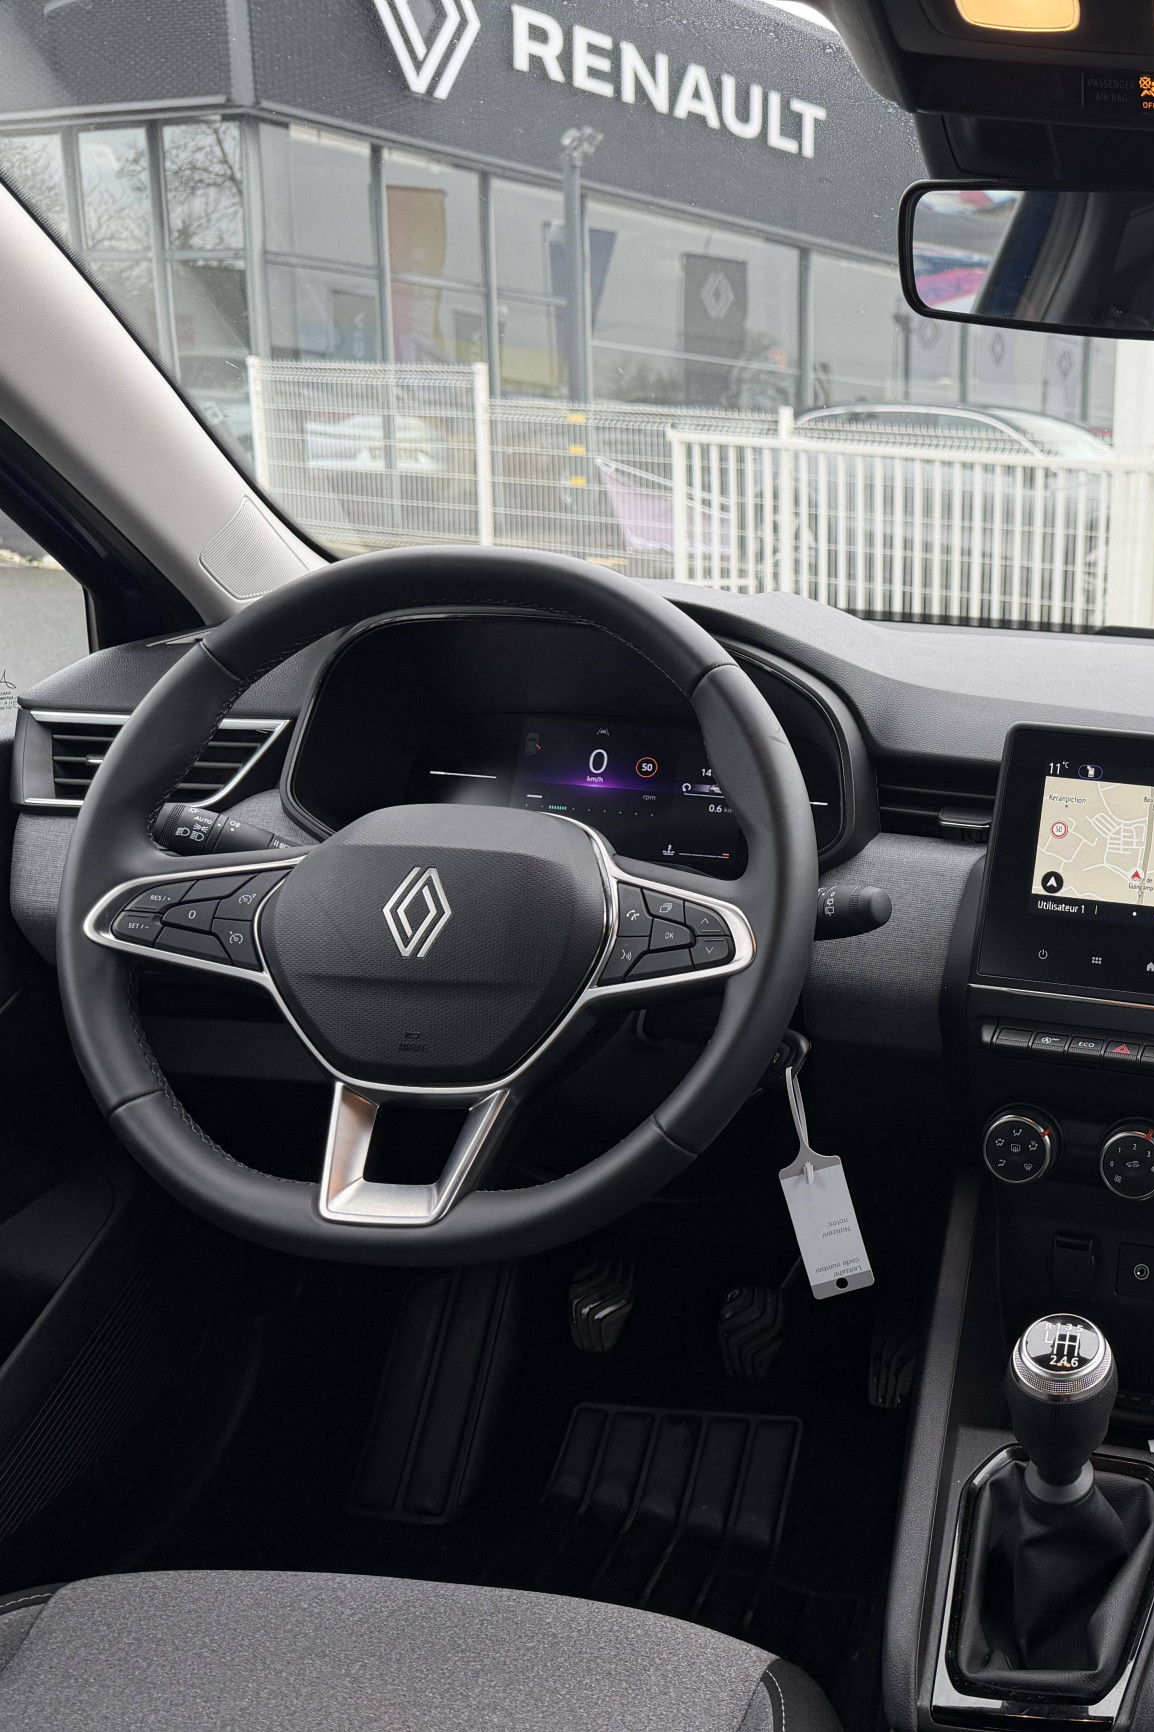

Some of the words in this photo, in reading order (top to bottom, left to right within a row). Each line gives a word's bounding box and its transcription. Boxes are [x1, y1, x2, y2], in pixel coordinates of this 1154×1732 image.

[512, 4, 827, 158] RENAULT
[1087, 78, 1136, 90] PASSENGER
[589, 749, 608, 774] 0
[641, 763, 653, 772] 50
[1049, 762, 1061, 775] 11
[586, 775, 604, 783] km/h
[642, 793, 656, 801] rpm
[708, 804, 723, 813] 0.6
[193, 815, 213, 826] AUTO
[1055, 825, 1063, 833] 50
[1037, 900, 1079, 913] Utilisateur
[1080, 904, 1085, 914] 1
[188, 910, 197, 919] 0
[664, 931, 674, 940] OK
[1132, 1143, 1137, 1151] 2
[1146, 1150, 1151, 1158] 3
[822, 1225, 851, 1239] Notizen/
[842, 1257, 860, 1266] code
[815, 1262, 841, 1274] number
[1045, 1322, 1053, 1330] R
[1065, 1323, 1073, 1331] 3
[1077, 1324, 1084, 1332] 5
[1049, 1355, 1057, 1365] 2
[1059, 1356, 1068, 1365] 4
[1070, 1357, 1079, 1368] 6
